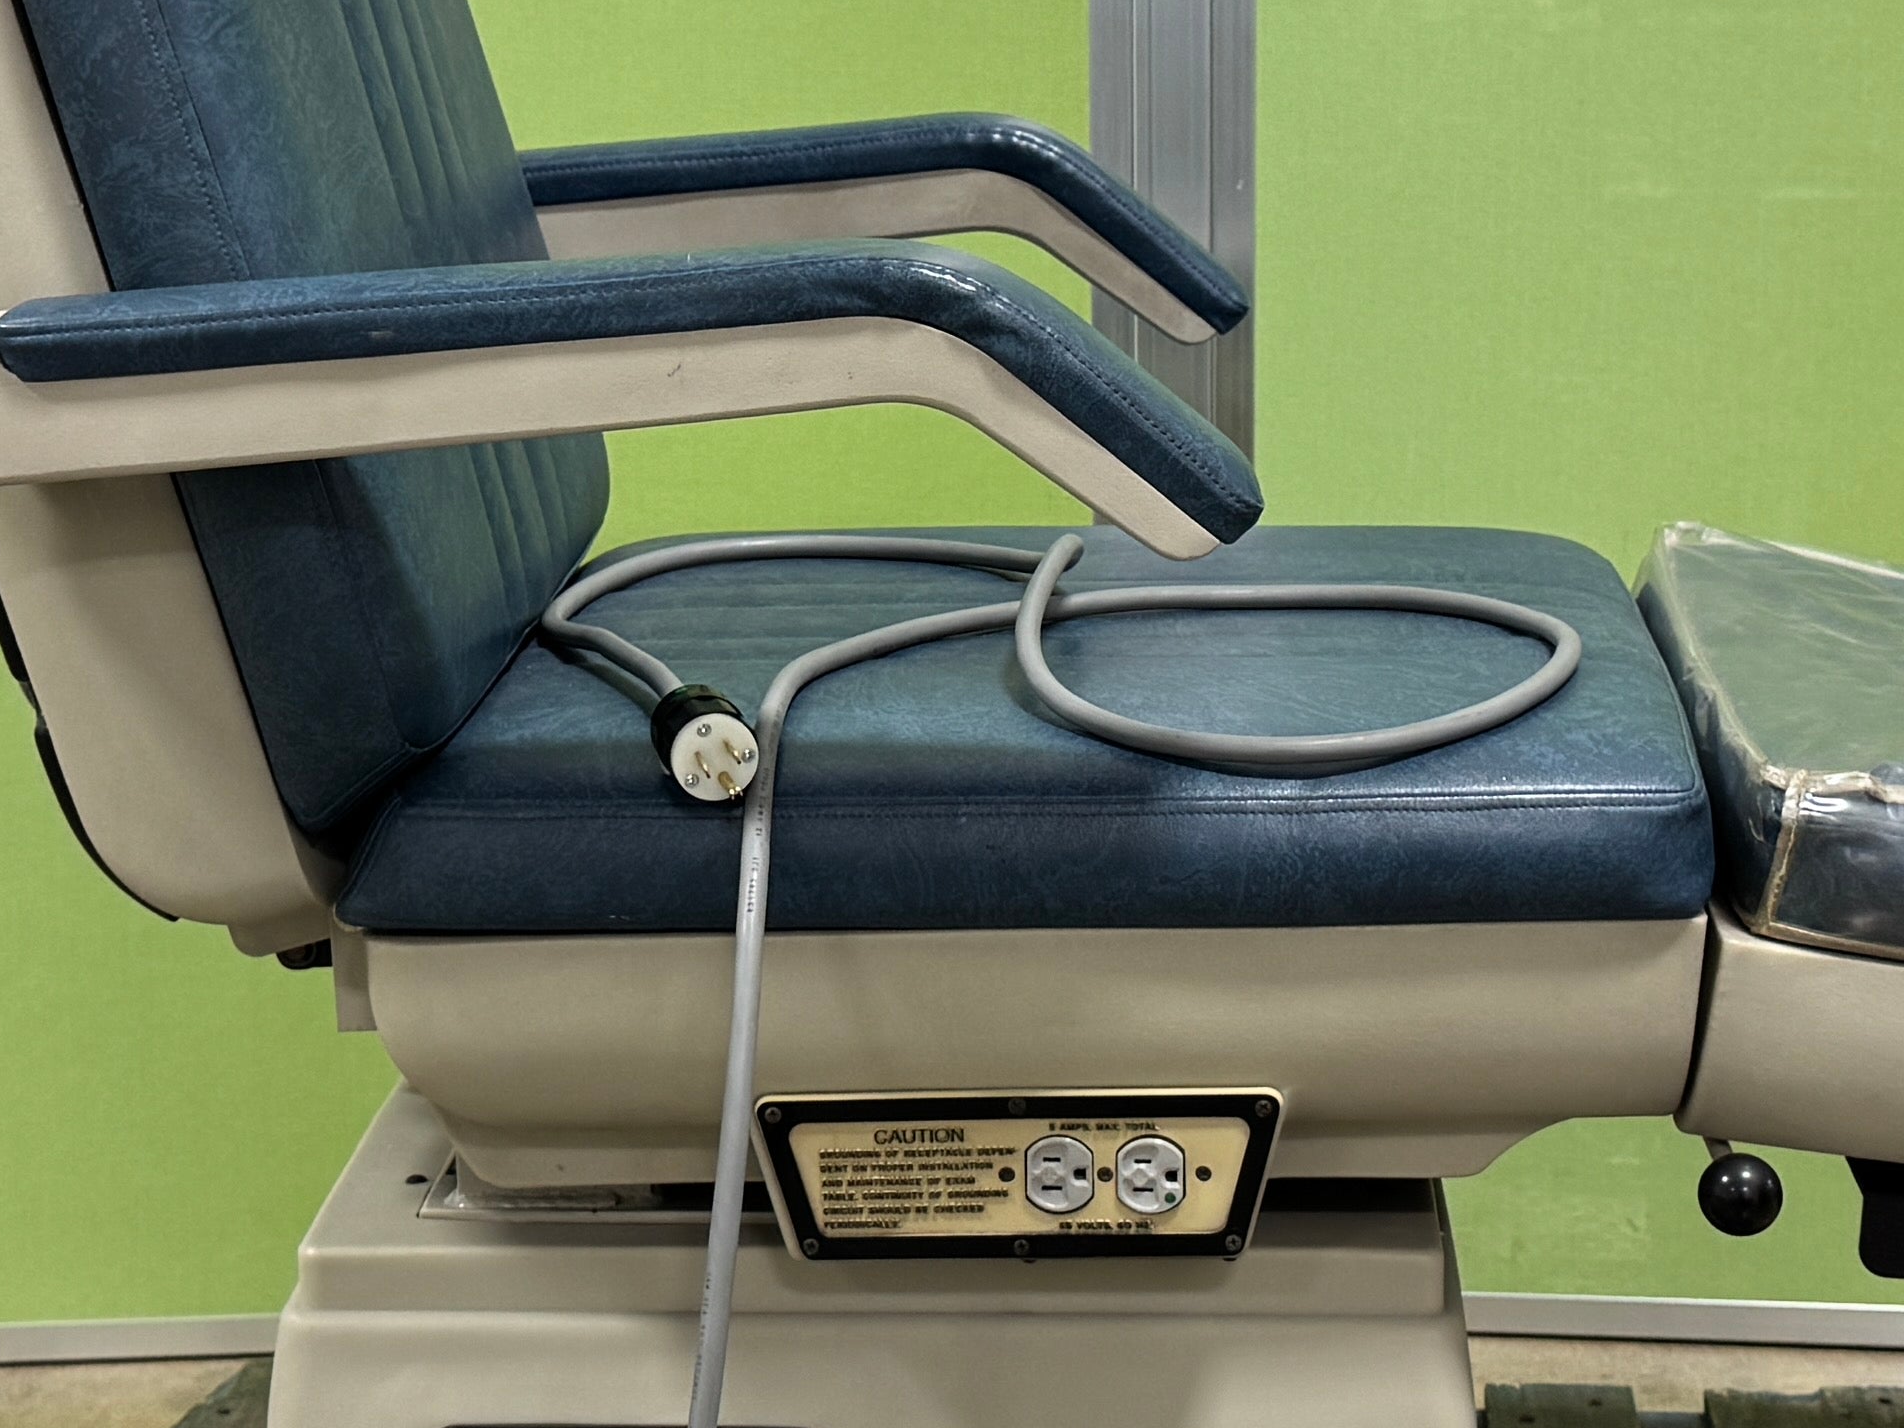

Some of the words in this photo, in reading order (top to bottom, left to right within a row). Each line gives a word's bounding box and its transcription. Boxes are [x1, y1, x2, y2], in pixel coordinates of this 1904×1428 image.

[873, 1128, 965, 1145] CAUTION
[870, 1162, 914, 1172] PROPER
[918, 1161, 994, 1171] INSTALLATION
